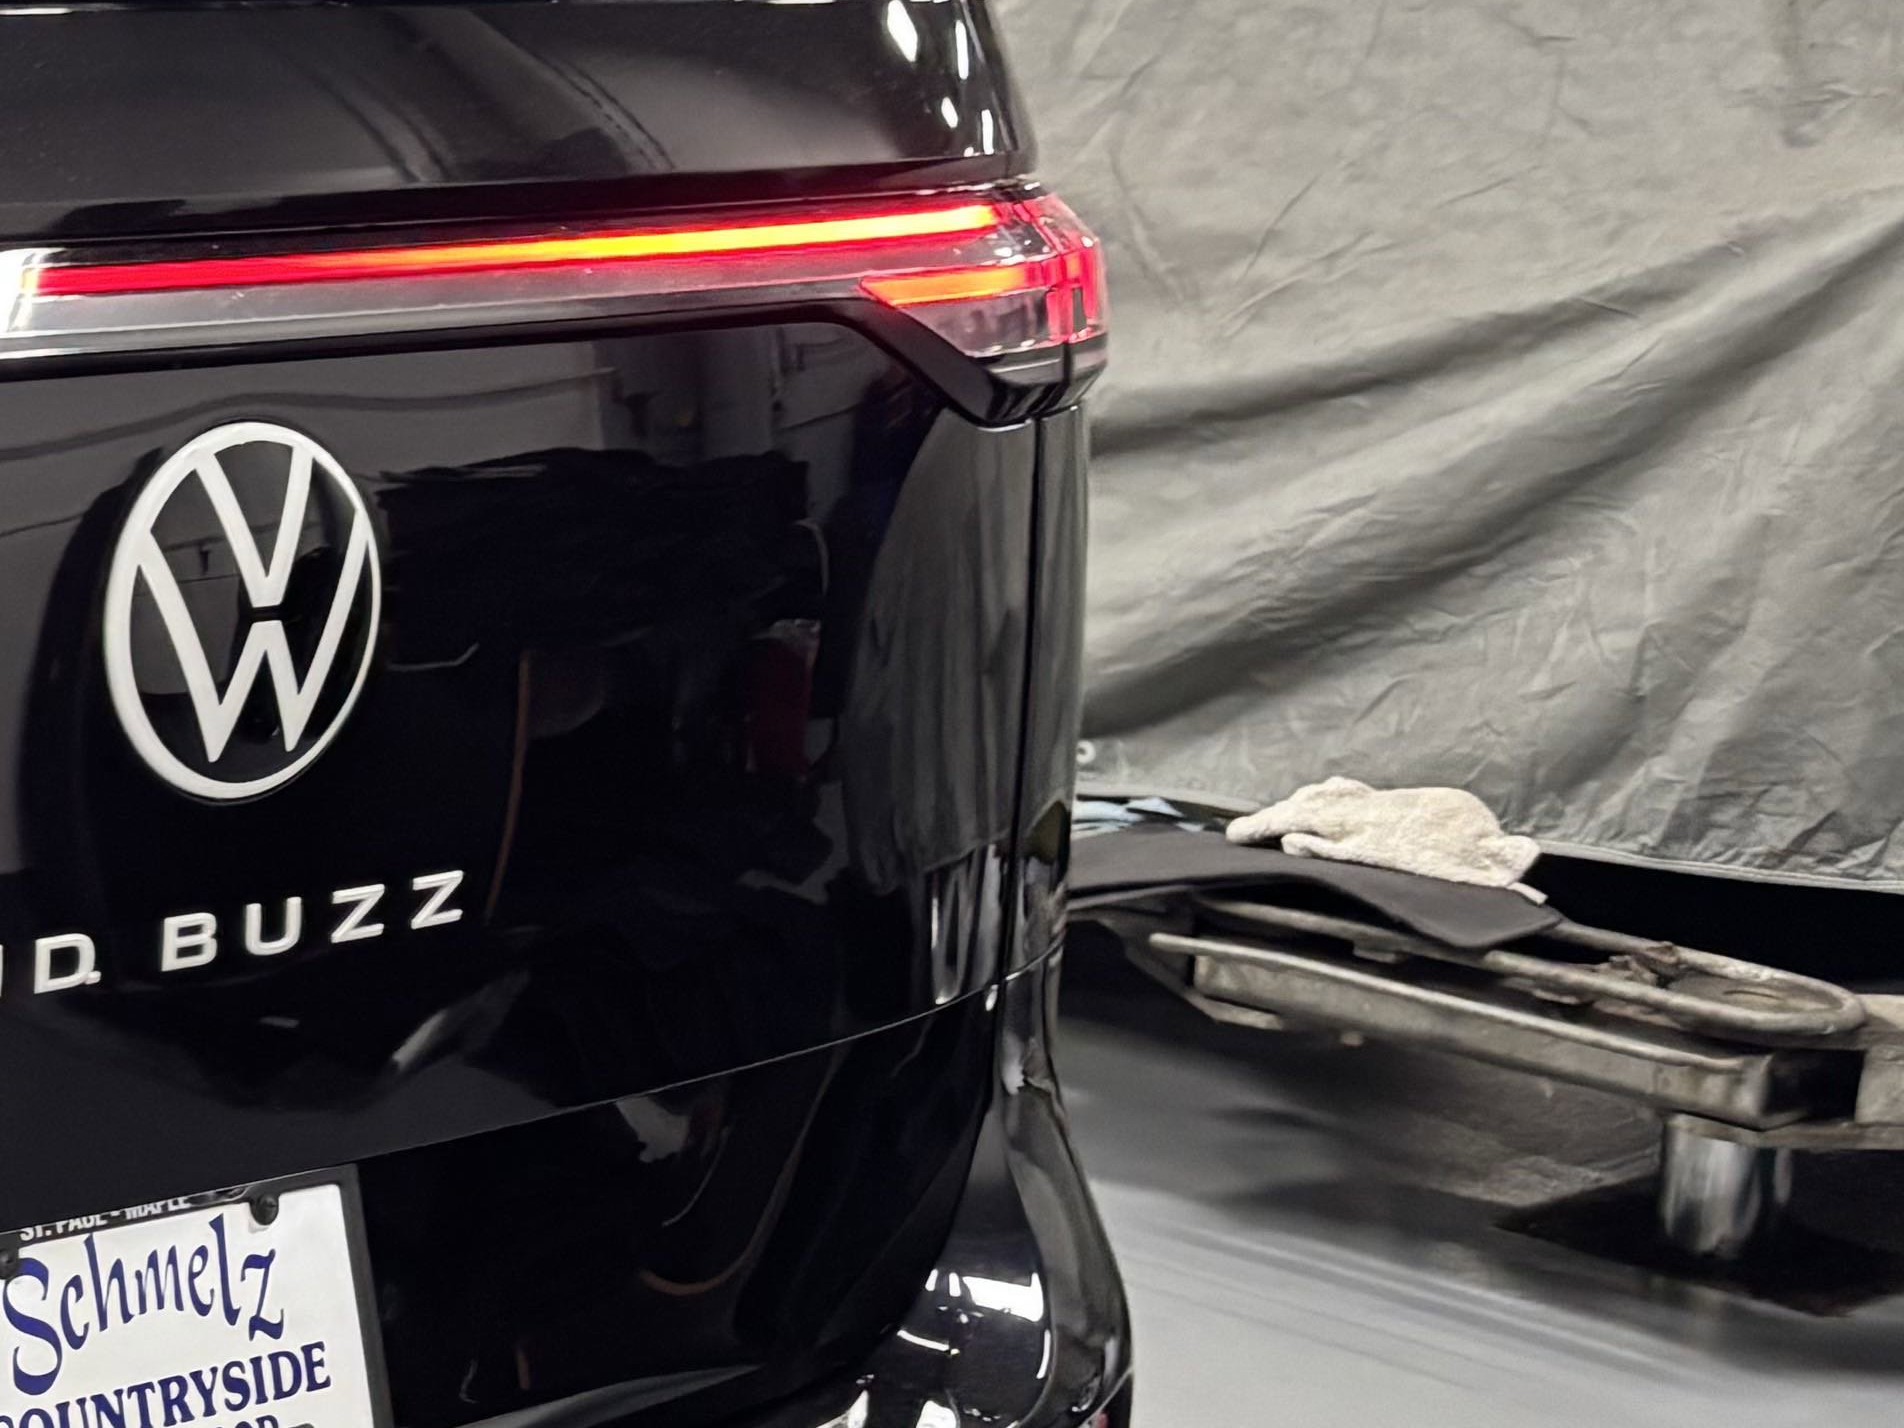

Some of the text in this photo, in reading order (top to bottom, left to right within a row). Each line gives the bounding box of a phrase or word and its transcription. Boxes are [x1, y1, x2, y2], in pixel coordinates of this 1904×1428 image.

[114, 430, 376, 787] VW
[161, 869, 464, 972] BUZZ
[1, 1212, 285, 1396] Schmelz
